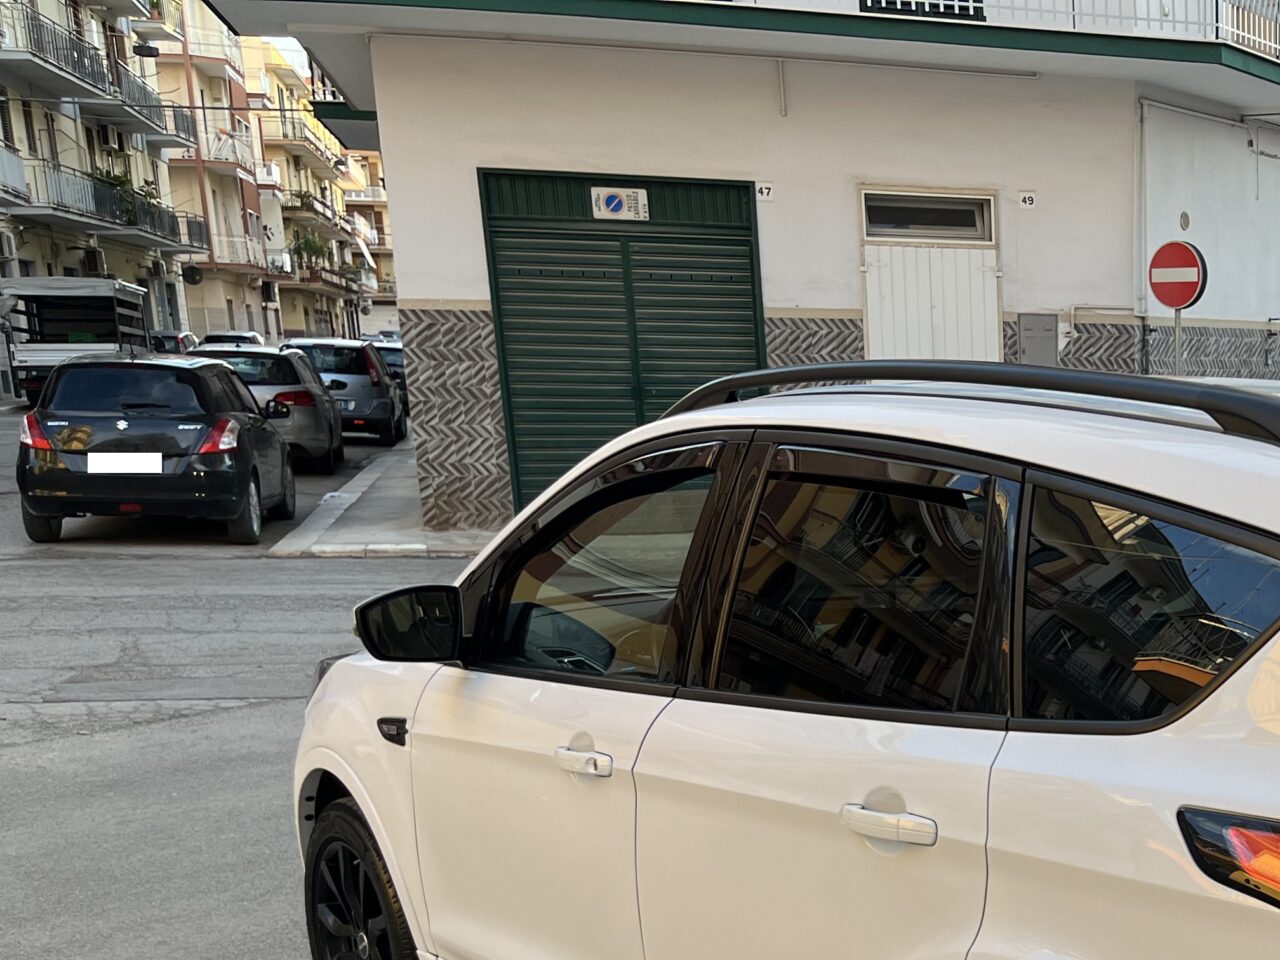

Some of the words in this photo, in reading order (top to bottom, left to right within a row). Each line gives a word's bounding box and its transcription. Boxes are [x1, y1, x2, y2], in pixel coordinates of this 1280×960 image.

[758, 186, 772, 197] 47
[626, 194, 634, 213] PASSO
[632, 191, 641, 219] CARRABILE
[1021, 195, 1035, 206] 49
